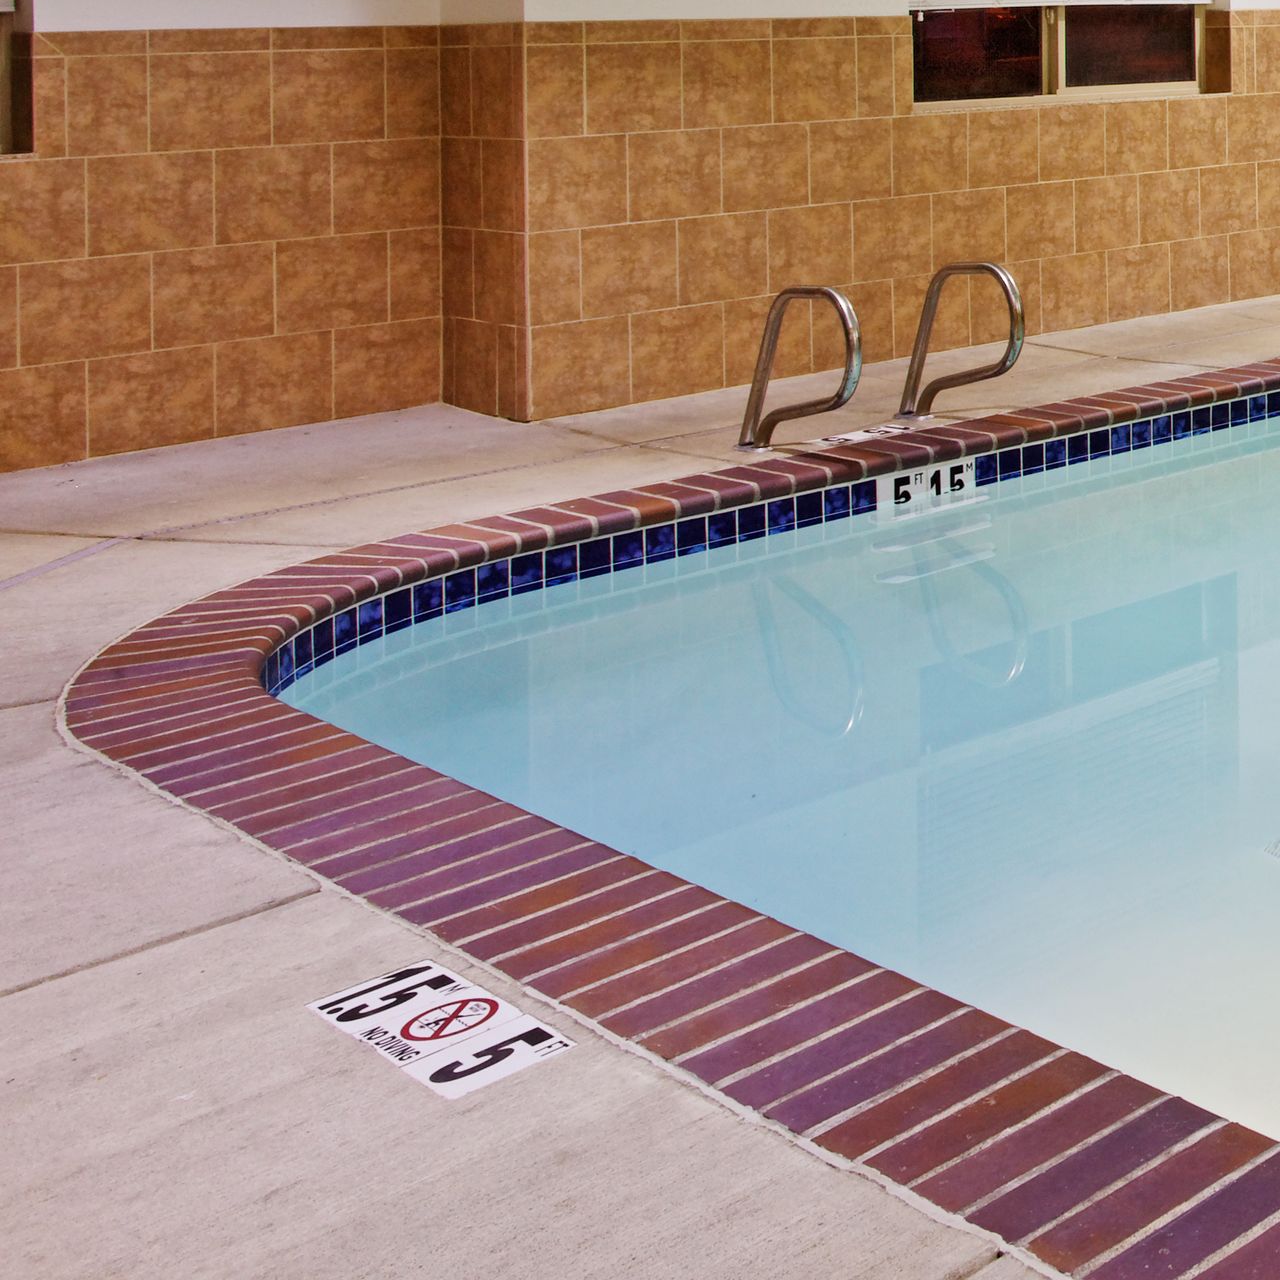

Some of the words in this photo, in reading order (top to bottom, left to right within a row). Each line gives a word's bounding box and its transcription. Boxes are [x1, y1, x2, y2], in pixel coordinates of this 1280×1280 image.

[894, 476, 911, 505] 5
[914, 472, 924, 486] FT
[965, 463, 973, 472] M
[360, 1026, 383, 1042] NO
[375, 1038, 421, 1062] DIVING
[429, 1026, 555, 1084] 5
